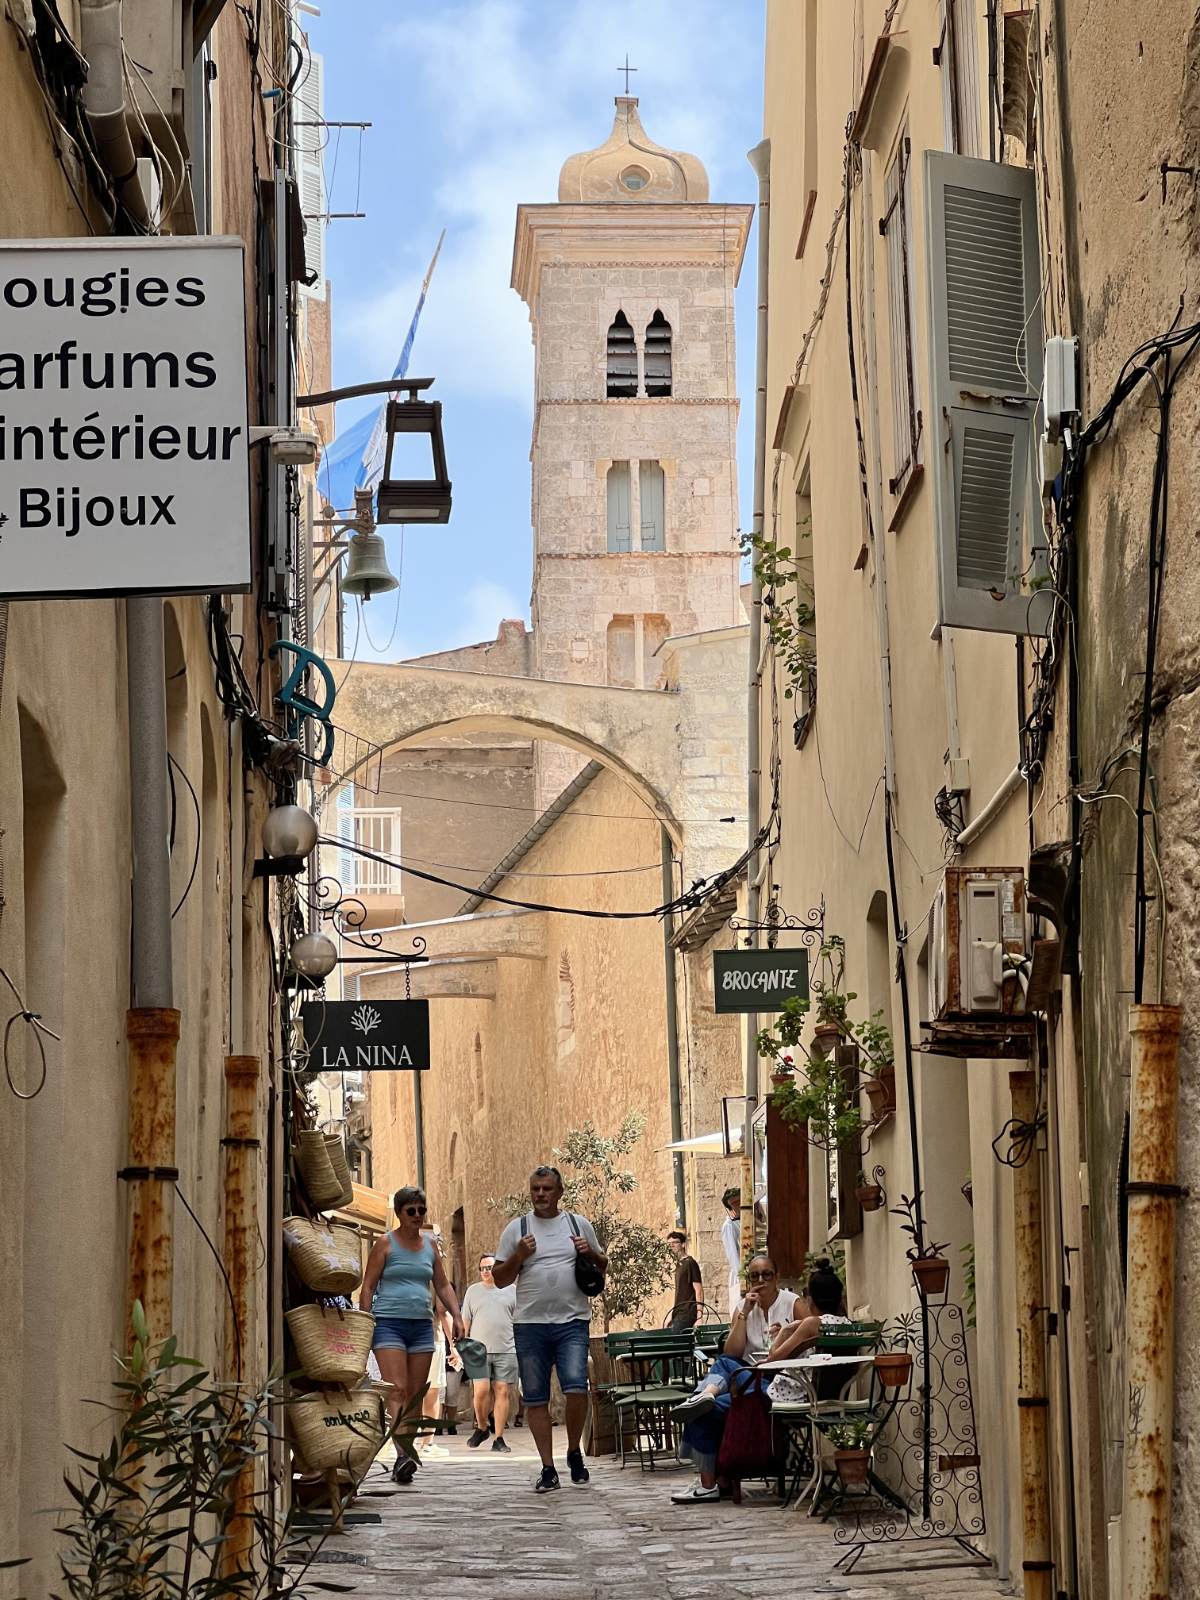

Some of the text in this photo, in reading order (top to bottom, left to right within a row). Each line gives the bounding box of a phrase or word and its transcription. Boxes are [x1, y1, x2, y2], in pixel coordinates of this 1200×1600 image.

[19, 486, 177, 537] Bijoux
[722, 969, 799, 993] BROCANTE
[322, 1045, 413, 1067] LA NINA
